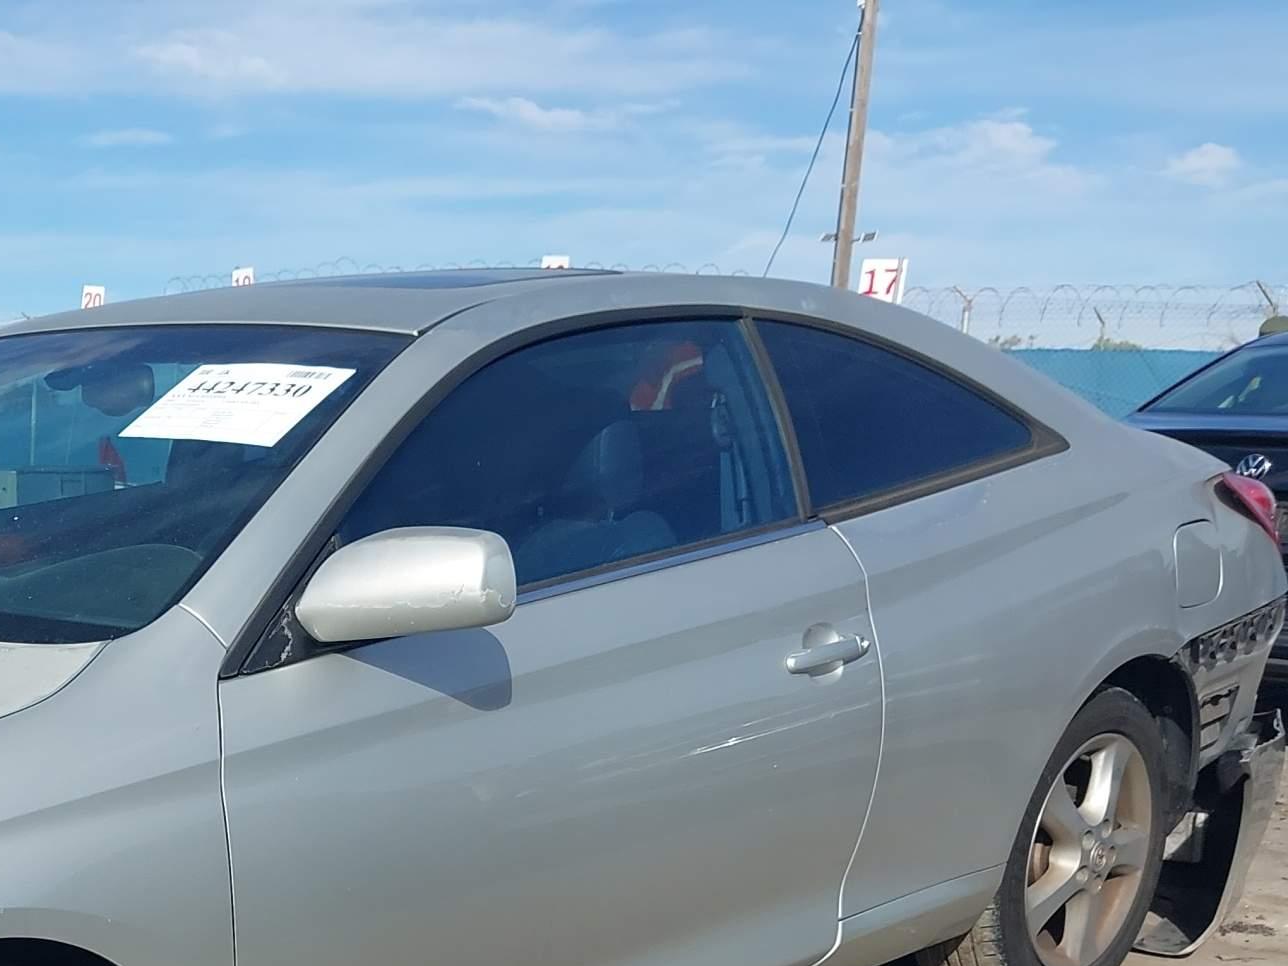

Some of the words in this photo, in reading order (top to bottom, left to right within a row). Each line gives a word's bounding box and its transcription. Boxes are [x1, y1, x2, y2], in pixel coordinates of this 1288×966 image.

[863, 268, 899, 295] 17
[84, 292, 102, 309] 20
[187, 380, 312, 398] 44247330
